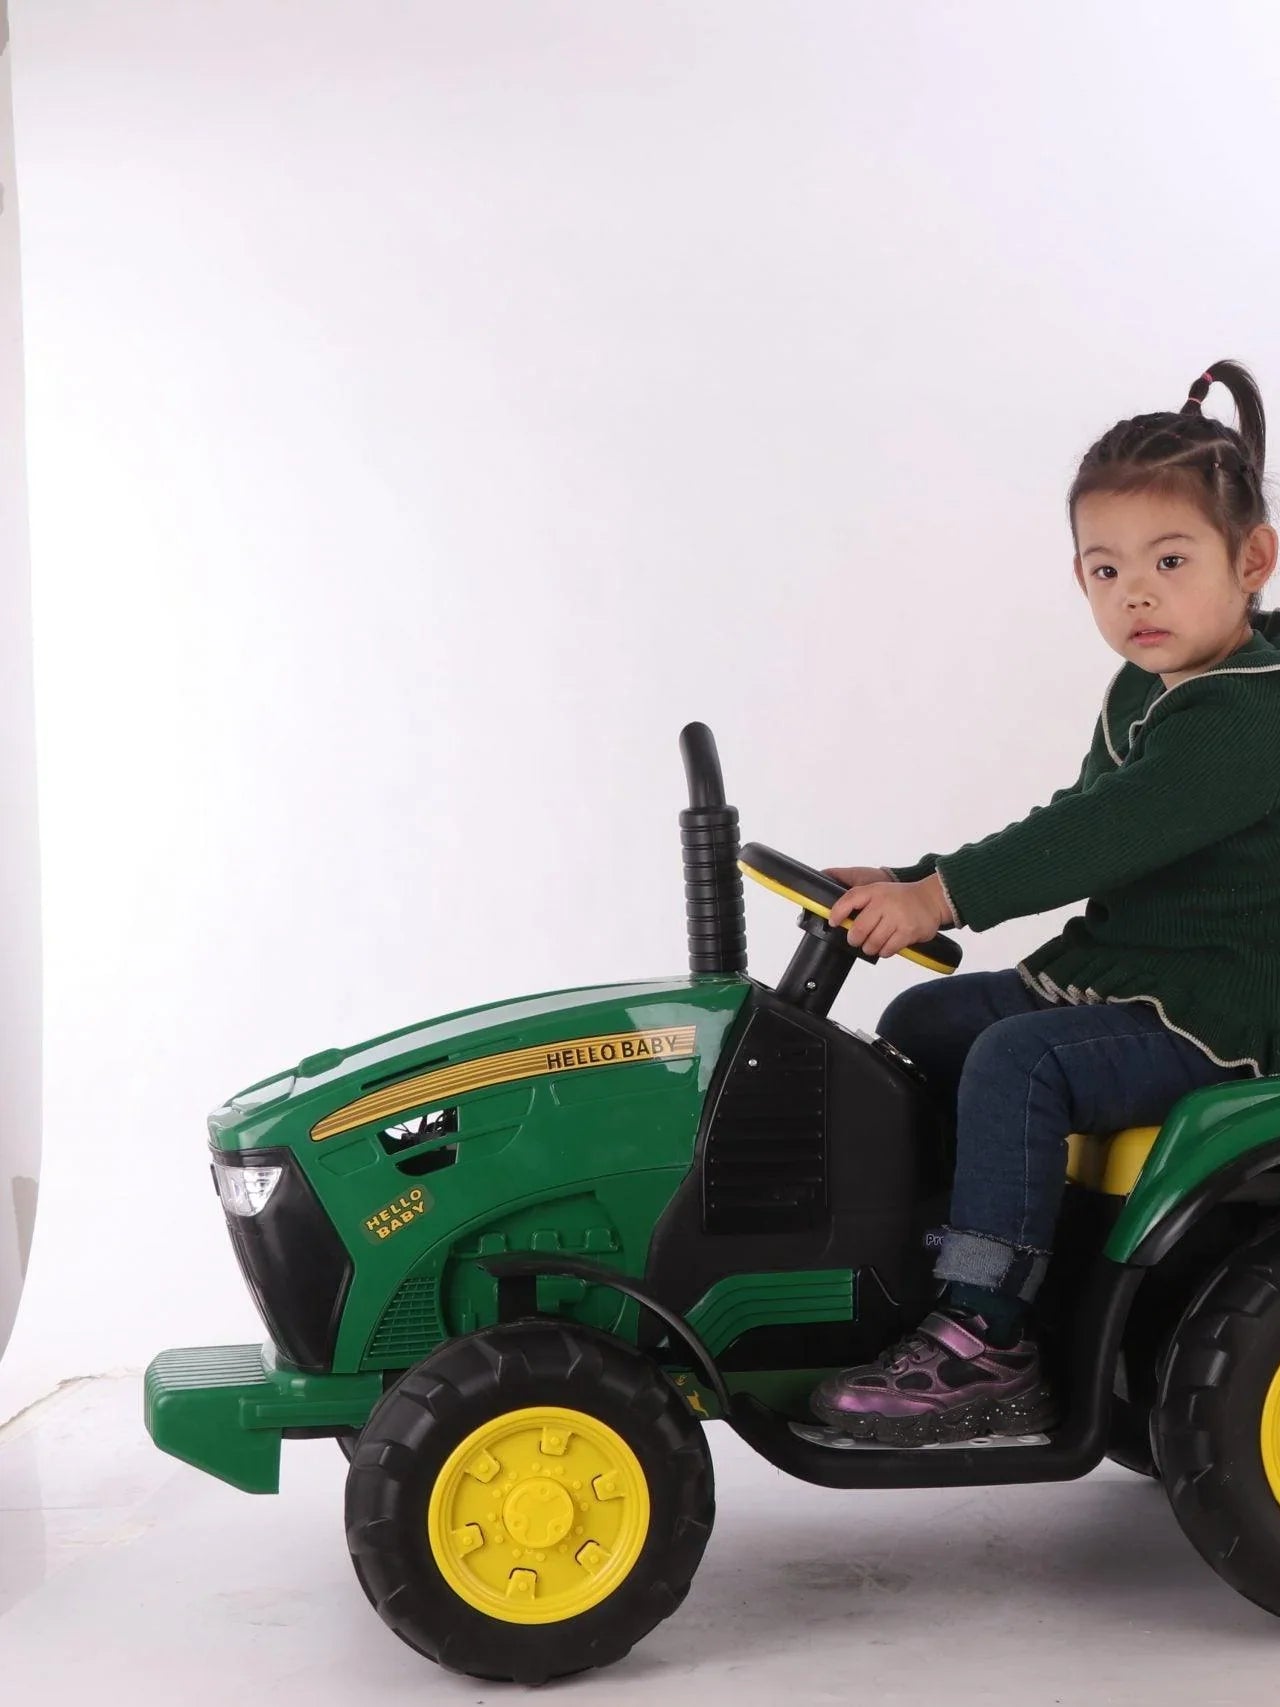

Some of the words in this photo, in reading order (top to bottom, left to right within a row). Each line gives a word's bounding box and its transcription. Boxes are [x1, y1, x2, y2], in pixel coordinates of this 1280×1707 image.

[546, 1044, 616, 1070] HELLO
[621, 1034, 678, 1059] BABY
[366, 1189, 422, 1231] HELLO
[376, 1201, 424, 1239] BABY
